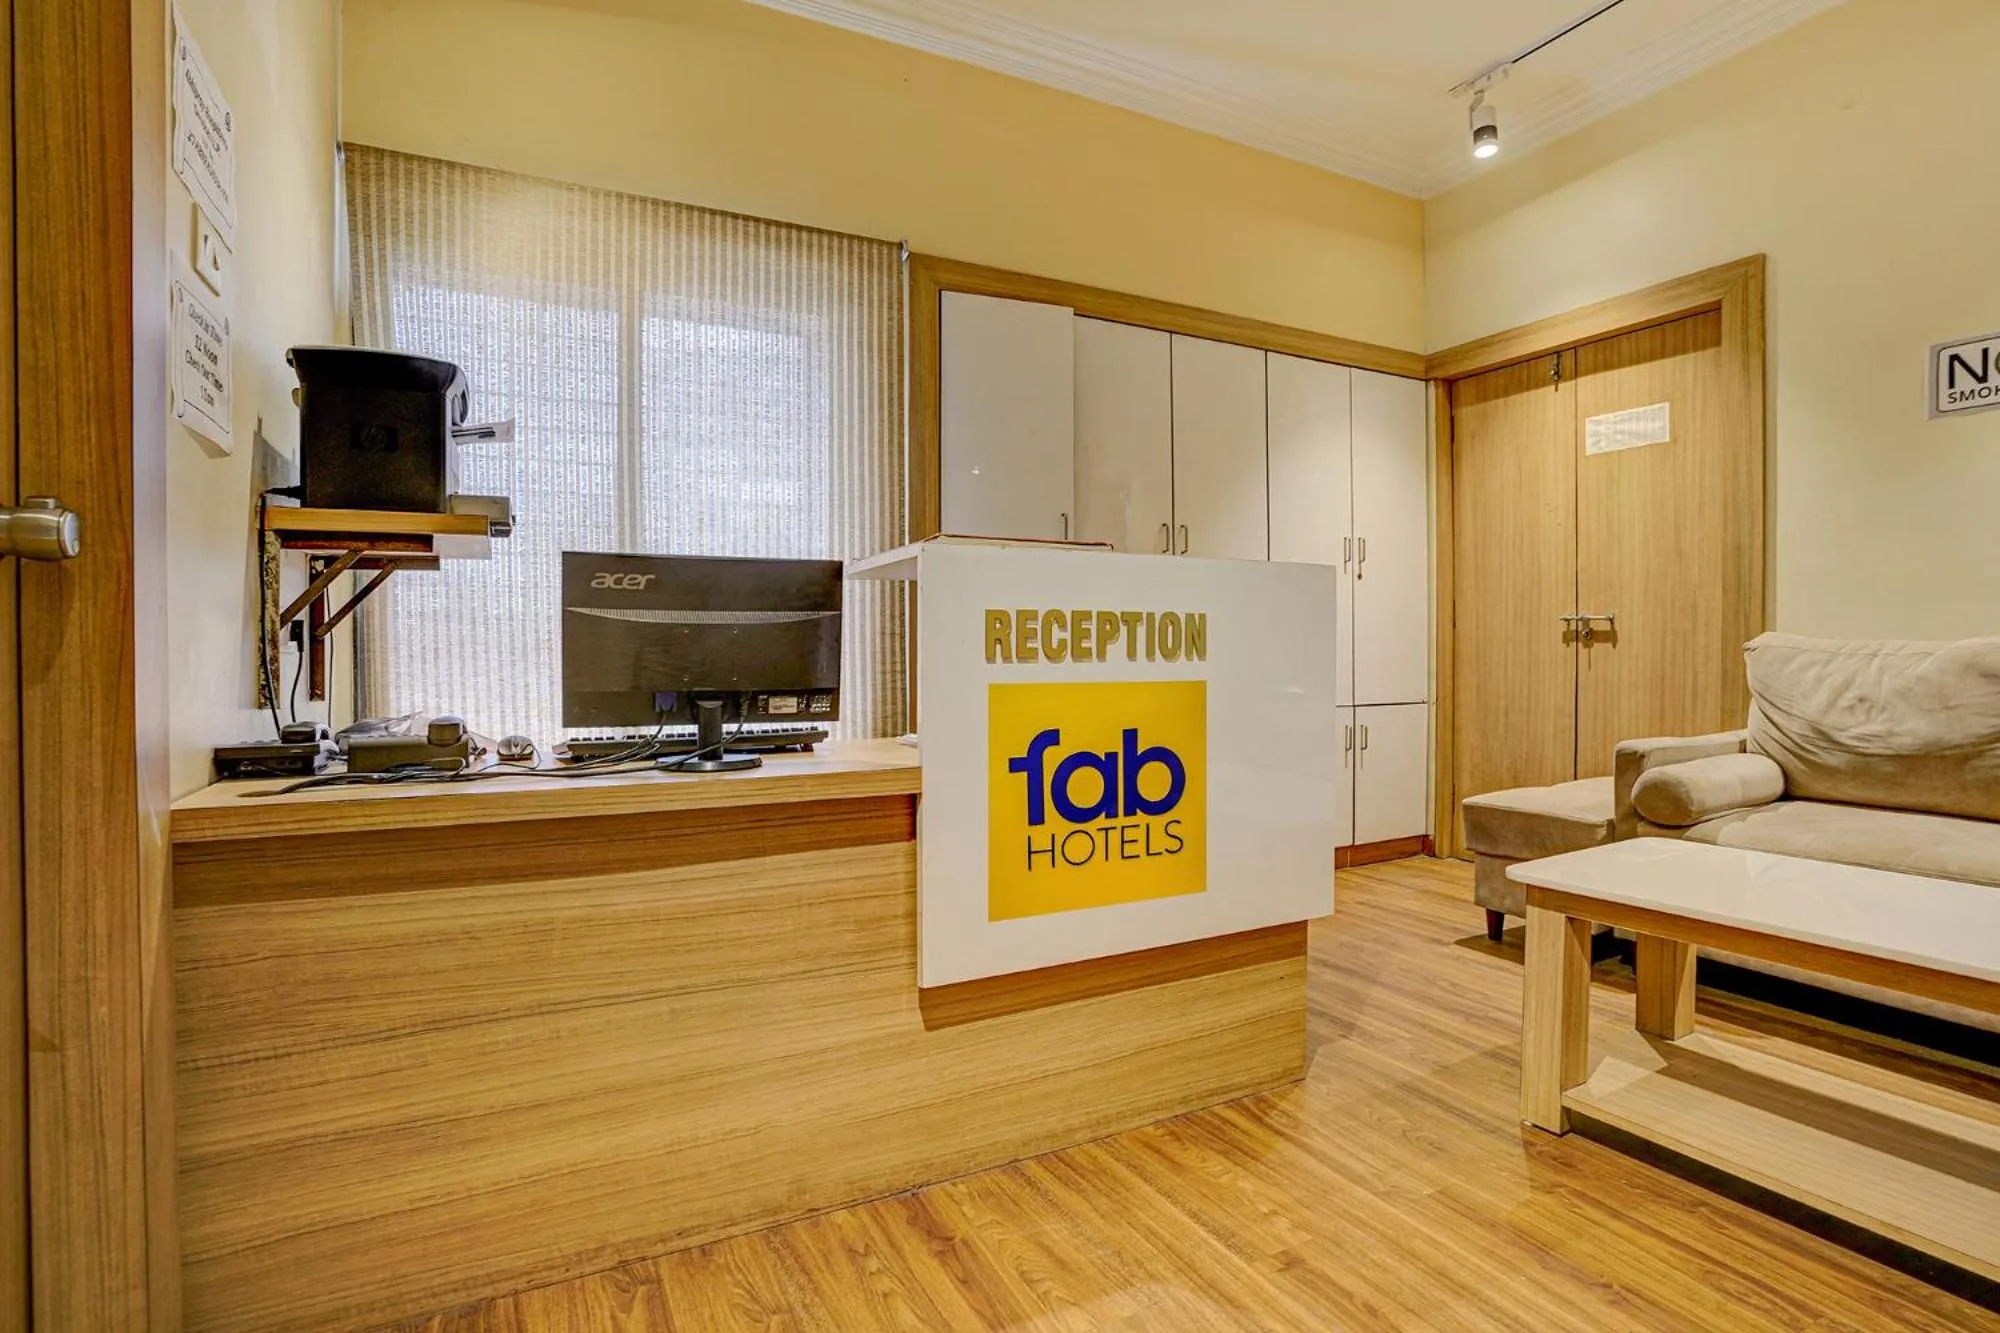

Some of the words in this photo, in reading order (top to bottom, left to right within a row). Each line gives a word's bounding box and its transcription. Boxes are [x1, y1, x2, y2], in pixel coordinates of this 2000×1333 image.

[1949, 347, 2000, 389] N
[590, 572, 656, 590] acer
[985, 608, 1208, 664] RECEPTION
[1008, 728, 1186, 826] fab
[1027, 820, 1184, 871] HOTELS
